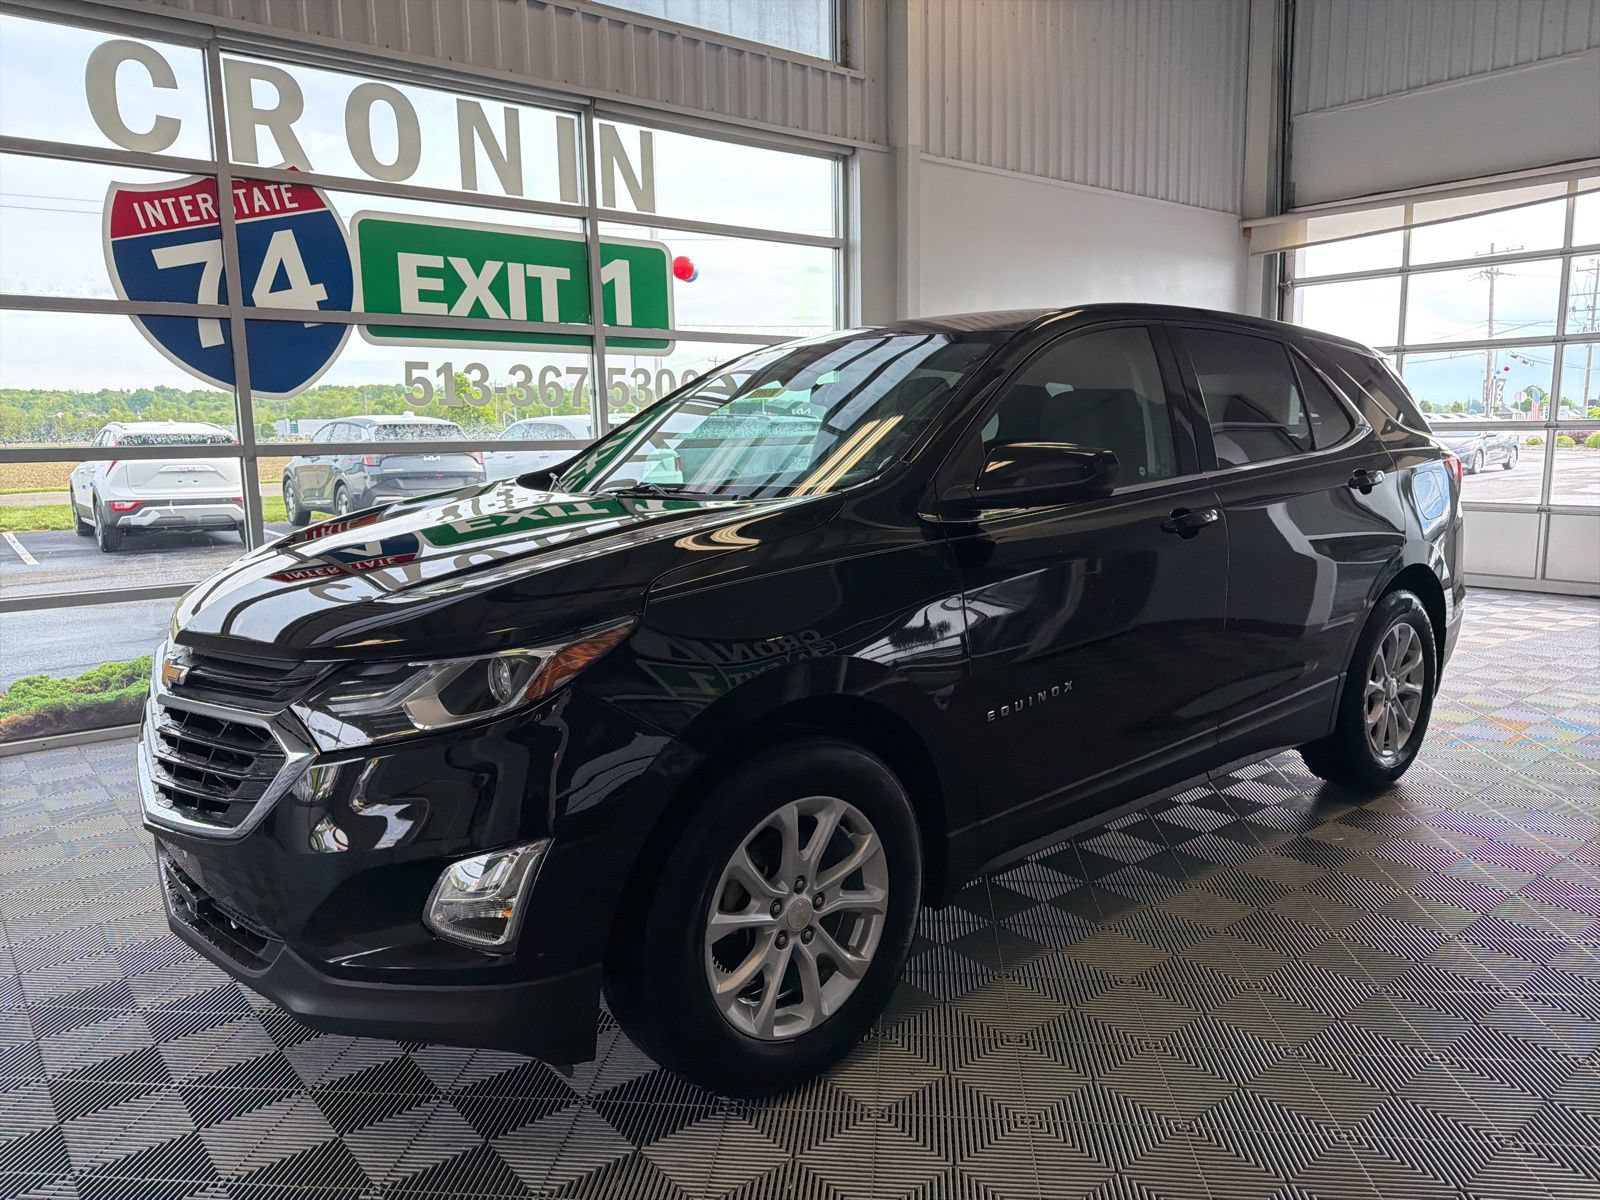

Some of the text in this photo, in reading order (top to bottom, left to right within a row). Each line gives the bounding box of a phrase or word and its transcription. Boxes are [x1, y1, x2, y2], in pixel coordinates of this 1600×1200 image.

[85, 39, 656, 214] CRONIN
[133, 184, 299, 230] INTERTATE
[151, 229, 329, 348] 74
[397, 252, 633, 327] EXIT 1
[987, 680, 1073, 722] EQUINOX
